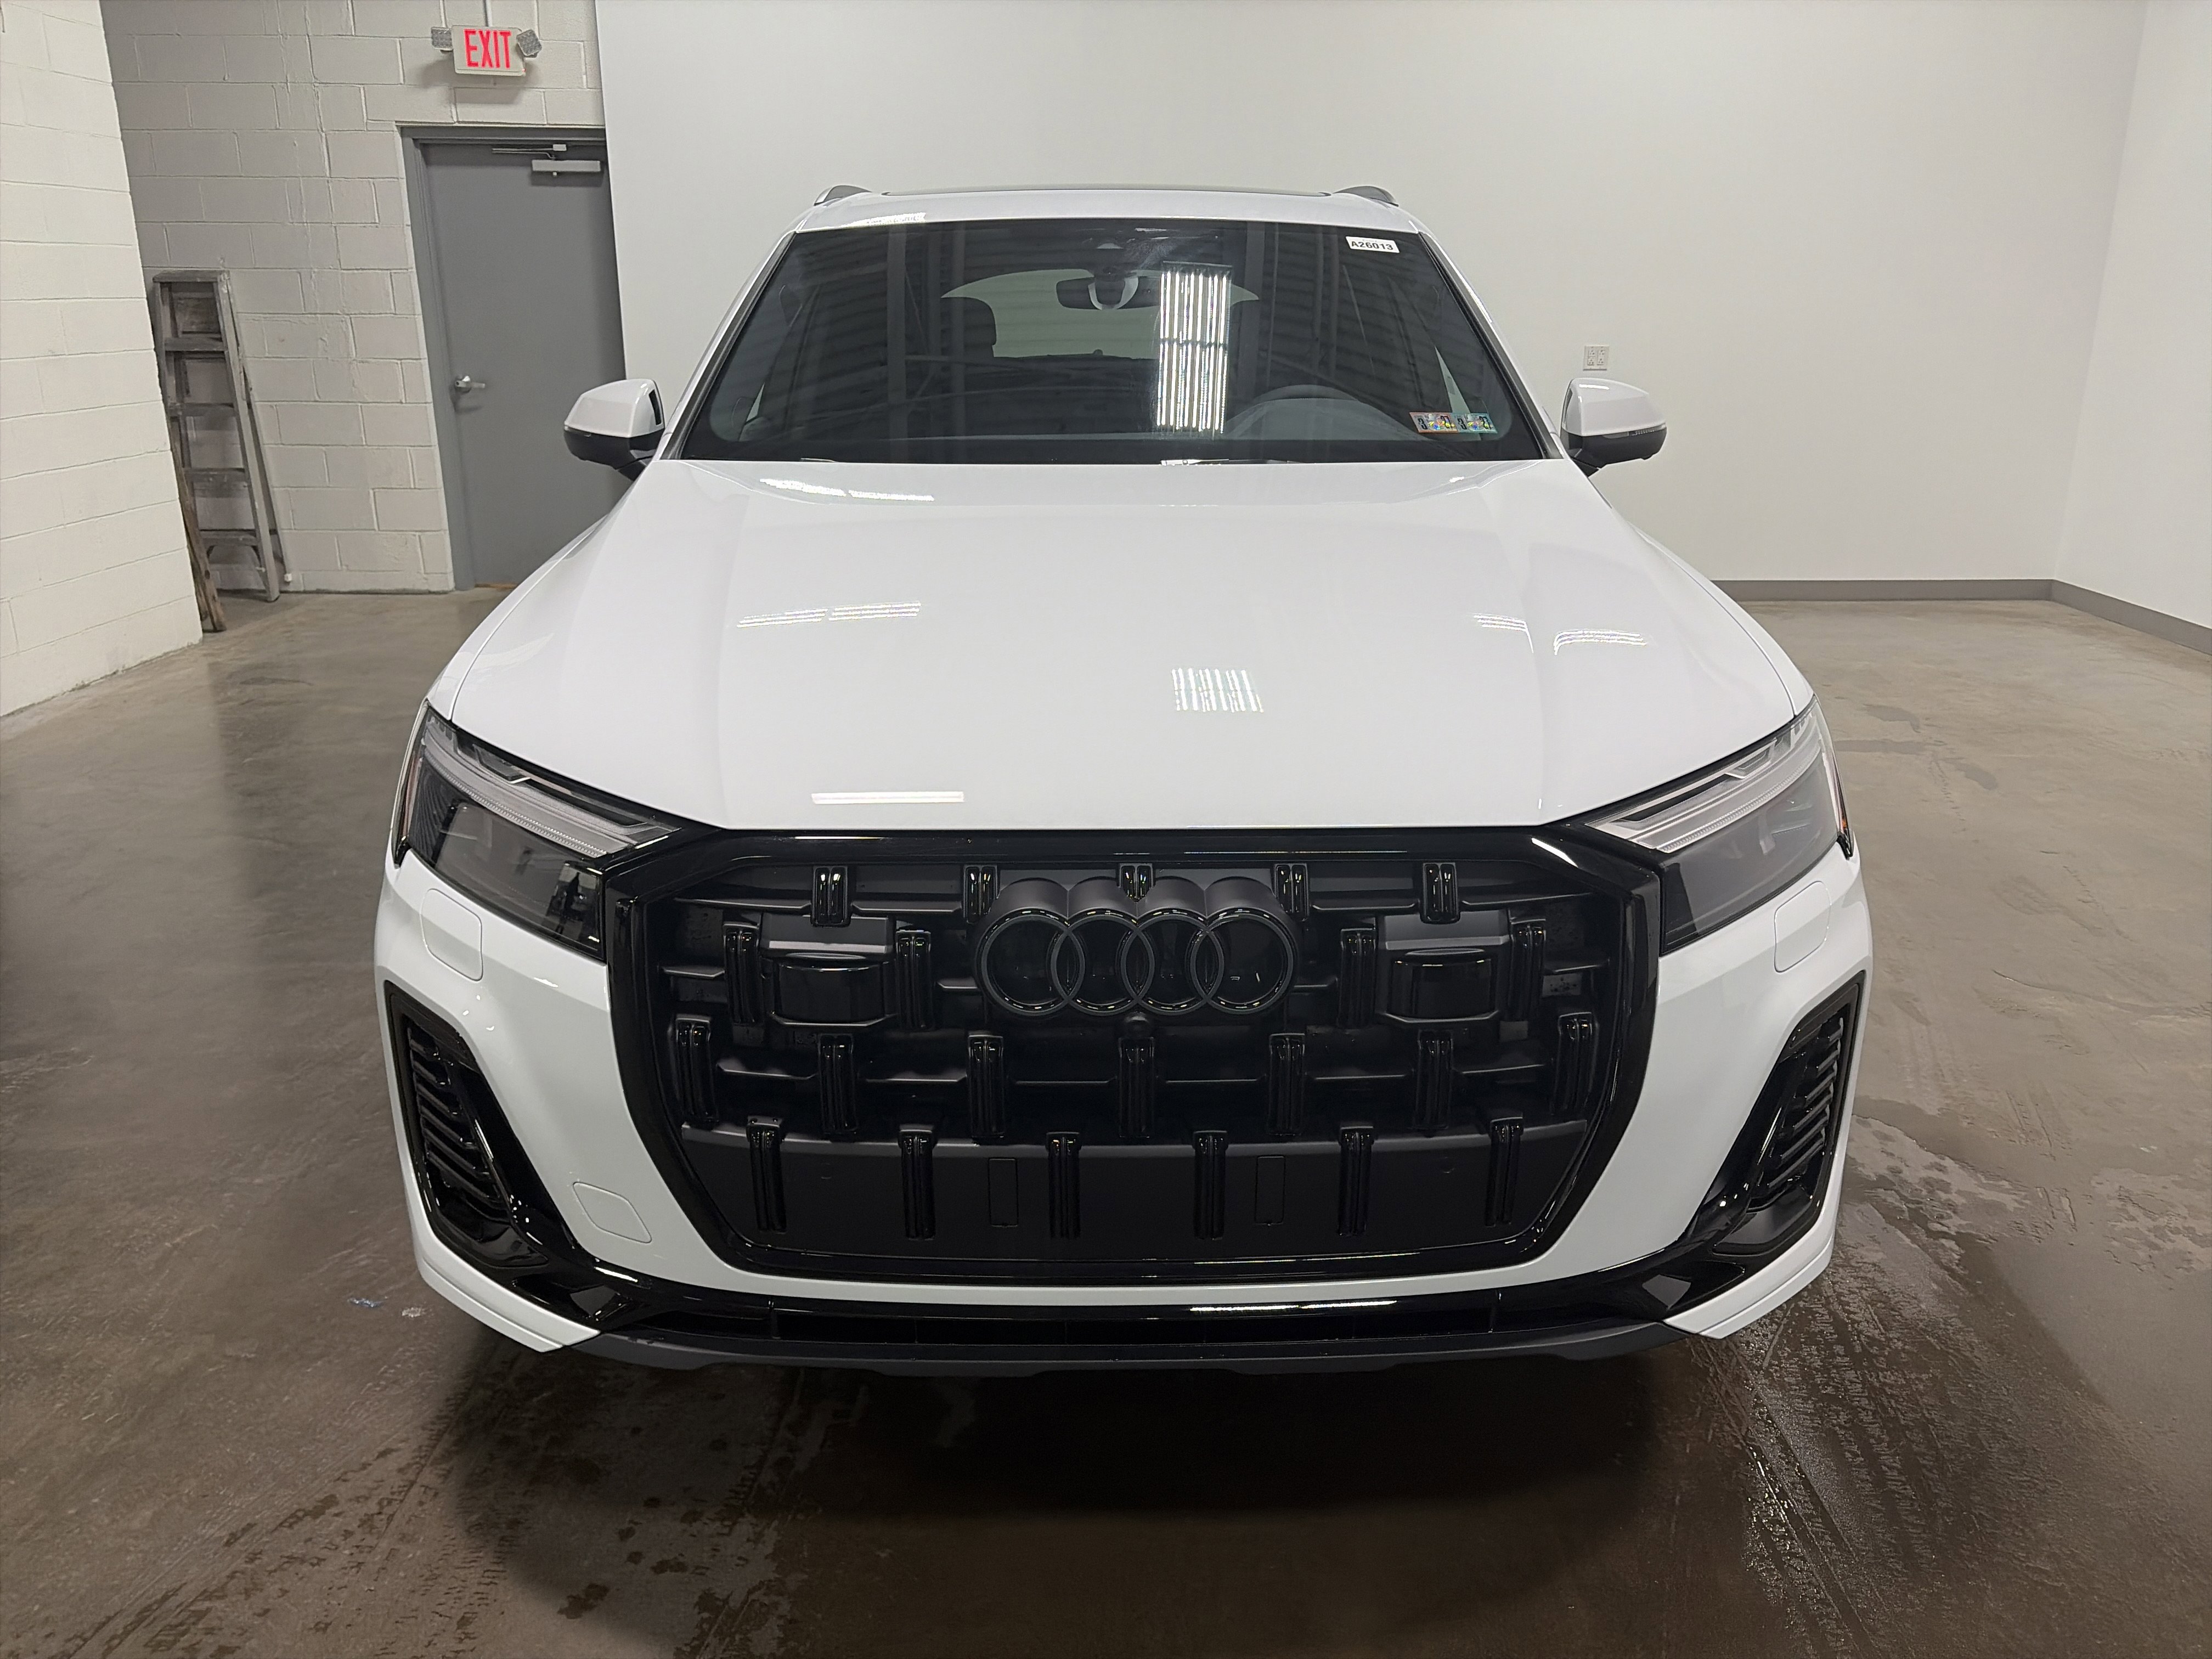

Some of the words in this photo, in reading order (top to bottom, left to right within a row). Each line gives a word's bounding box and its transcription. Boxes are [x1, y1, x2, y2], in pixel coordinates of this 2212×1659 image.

[464, 29, 511, 69] EXIT
[1351, 241, 1393, 250] A26013
[1417, 418, 1427, 430] 3
[1457, 418, 1468, 430] 3
